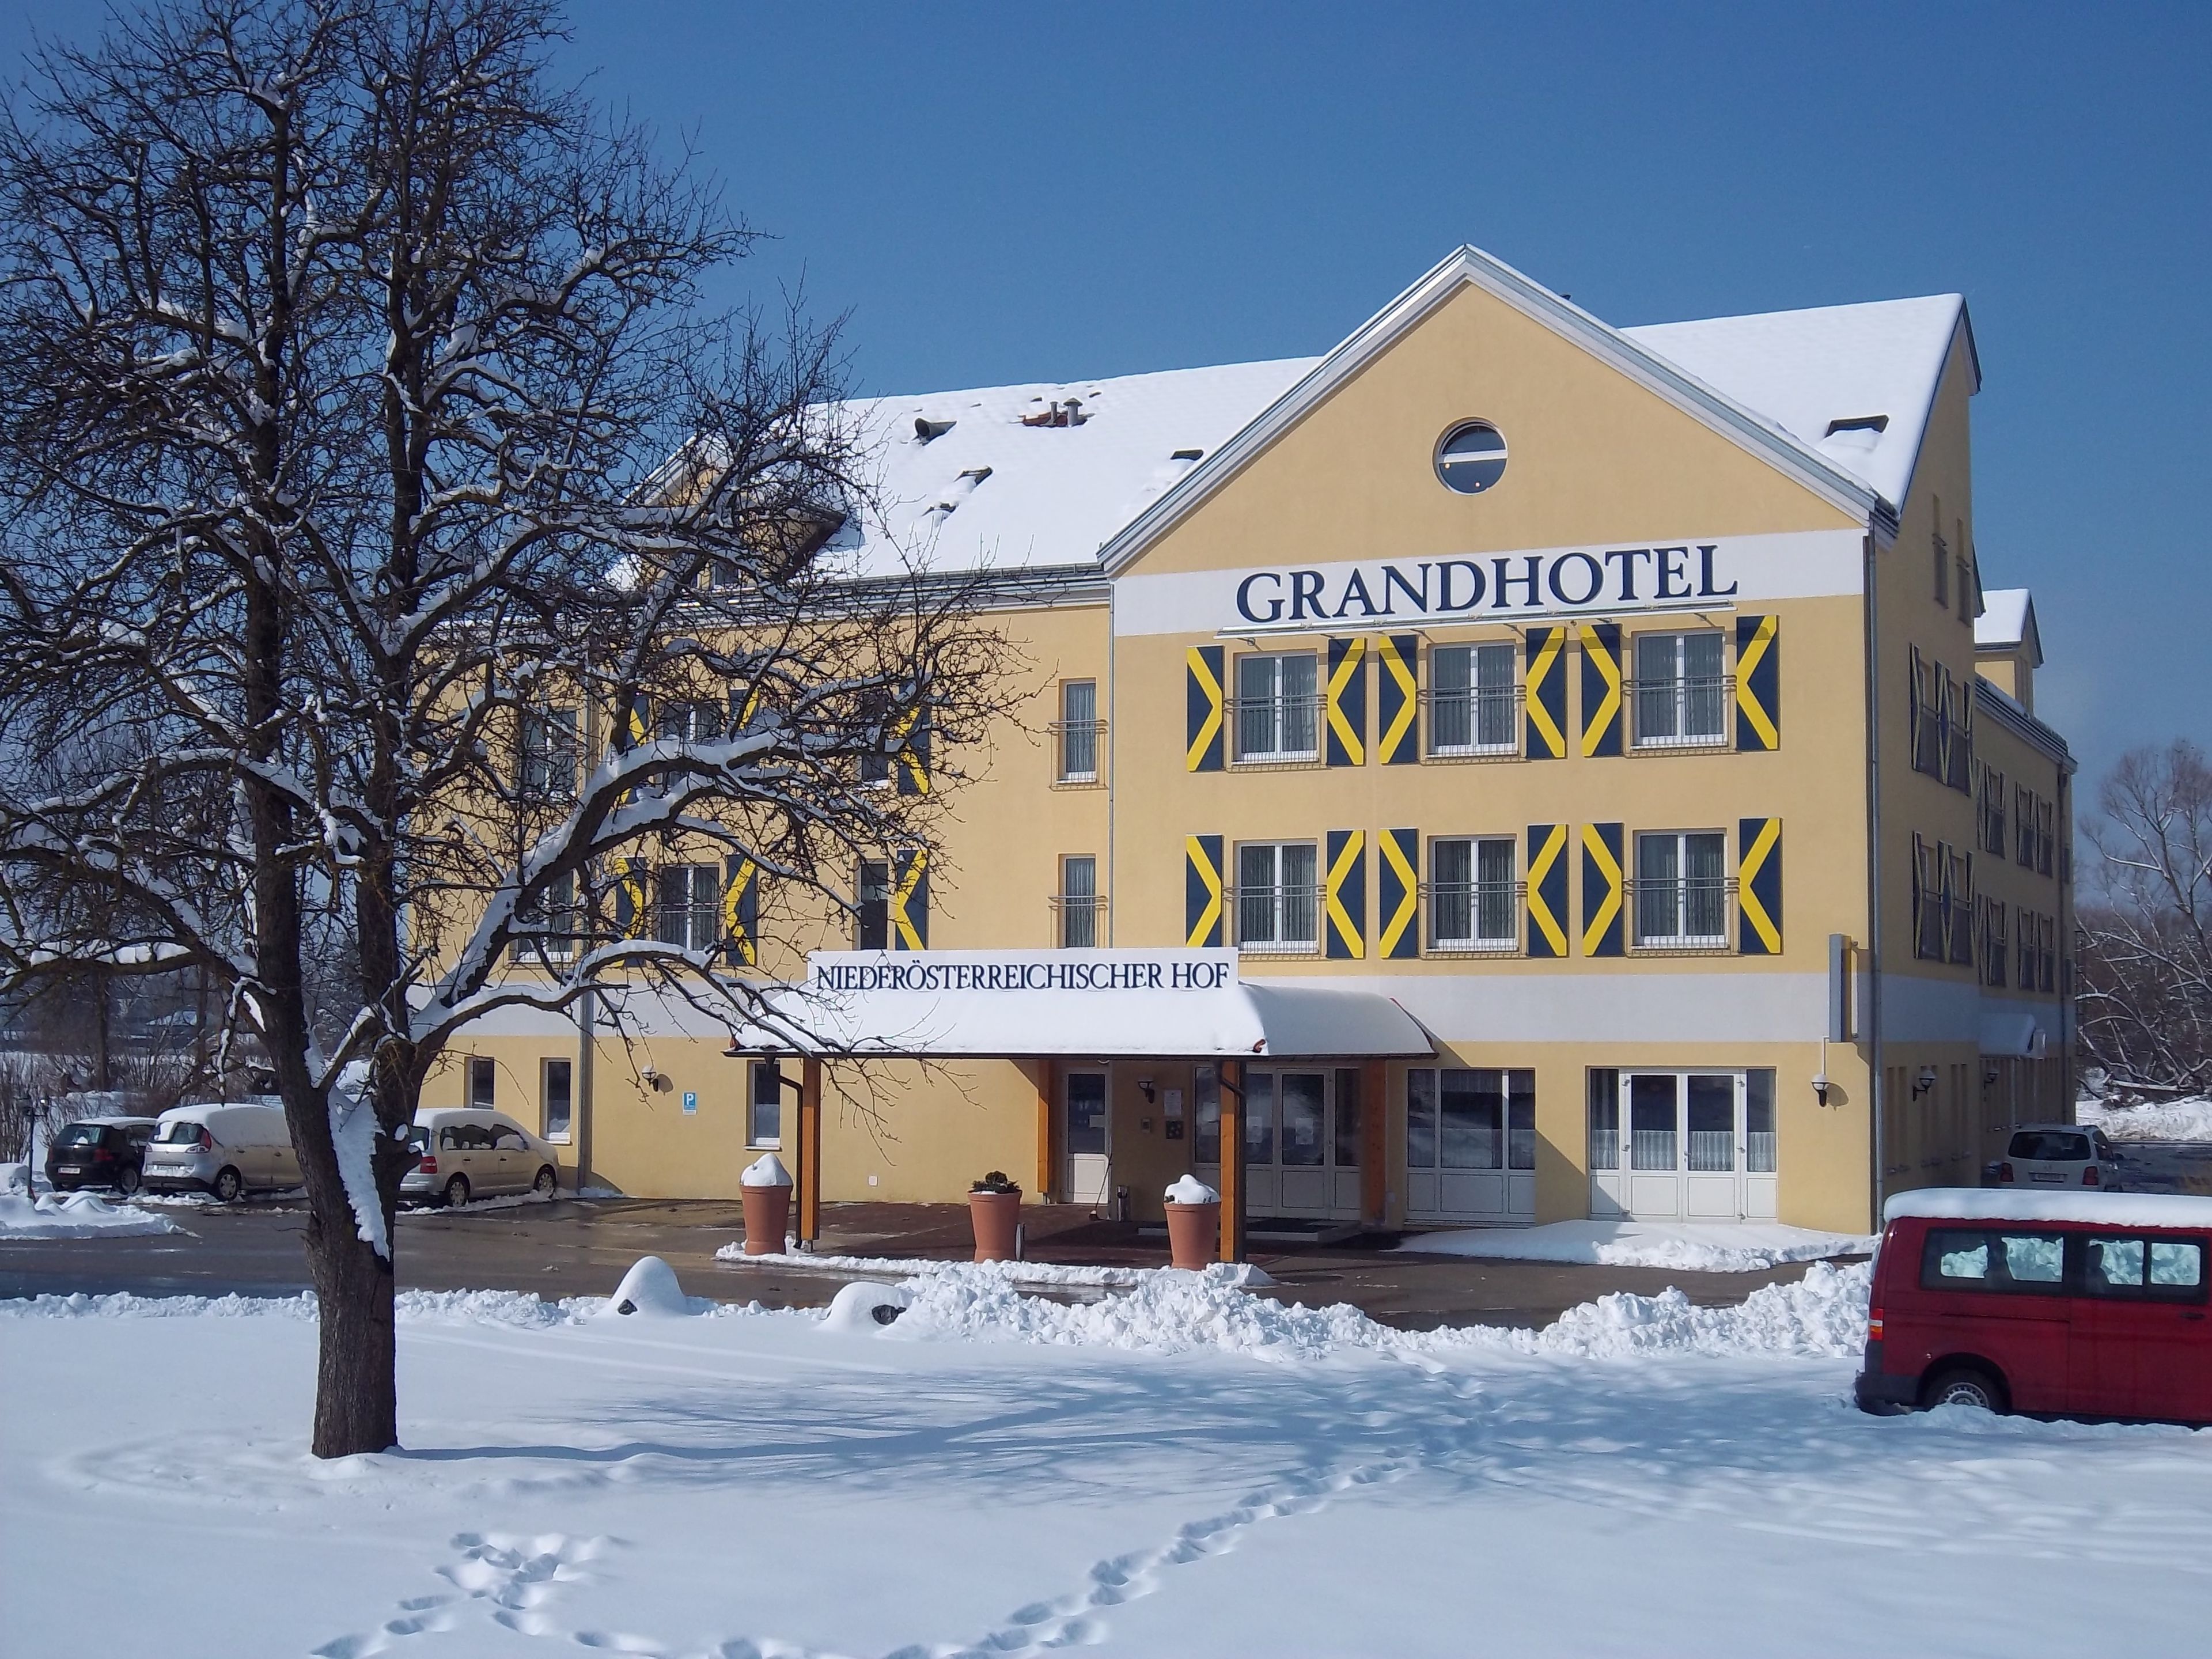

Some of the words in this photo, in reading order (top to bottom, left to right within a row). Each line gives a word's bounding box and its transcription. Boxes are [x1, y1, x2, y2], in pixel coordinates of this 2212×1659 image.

[1236, 544, 1738, 623] GRANDHOTEL
[816, 959, 1165, 990] NIEDERÖSTERREICHISCHER
[1171, 962, 1230, 988] HOF
[686, 1093, 694, 1105] P
